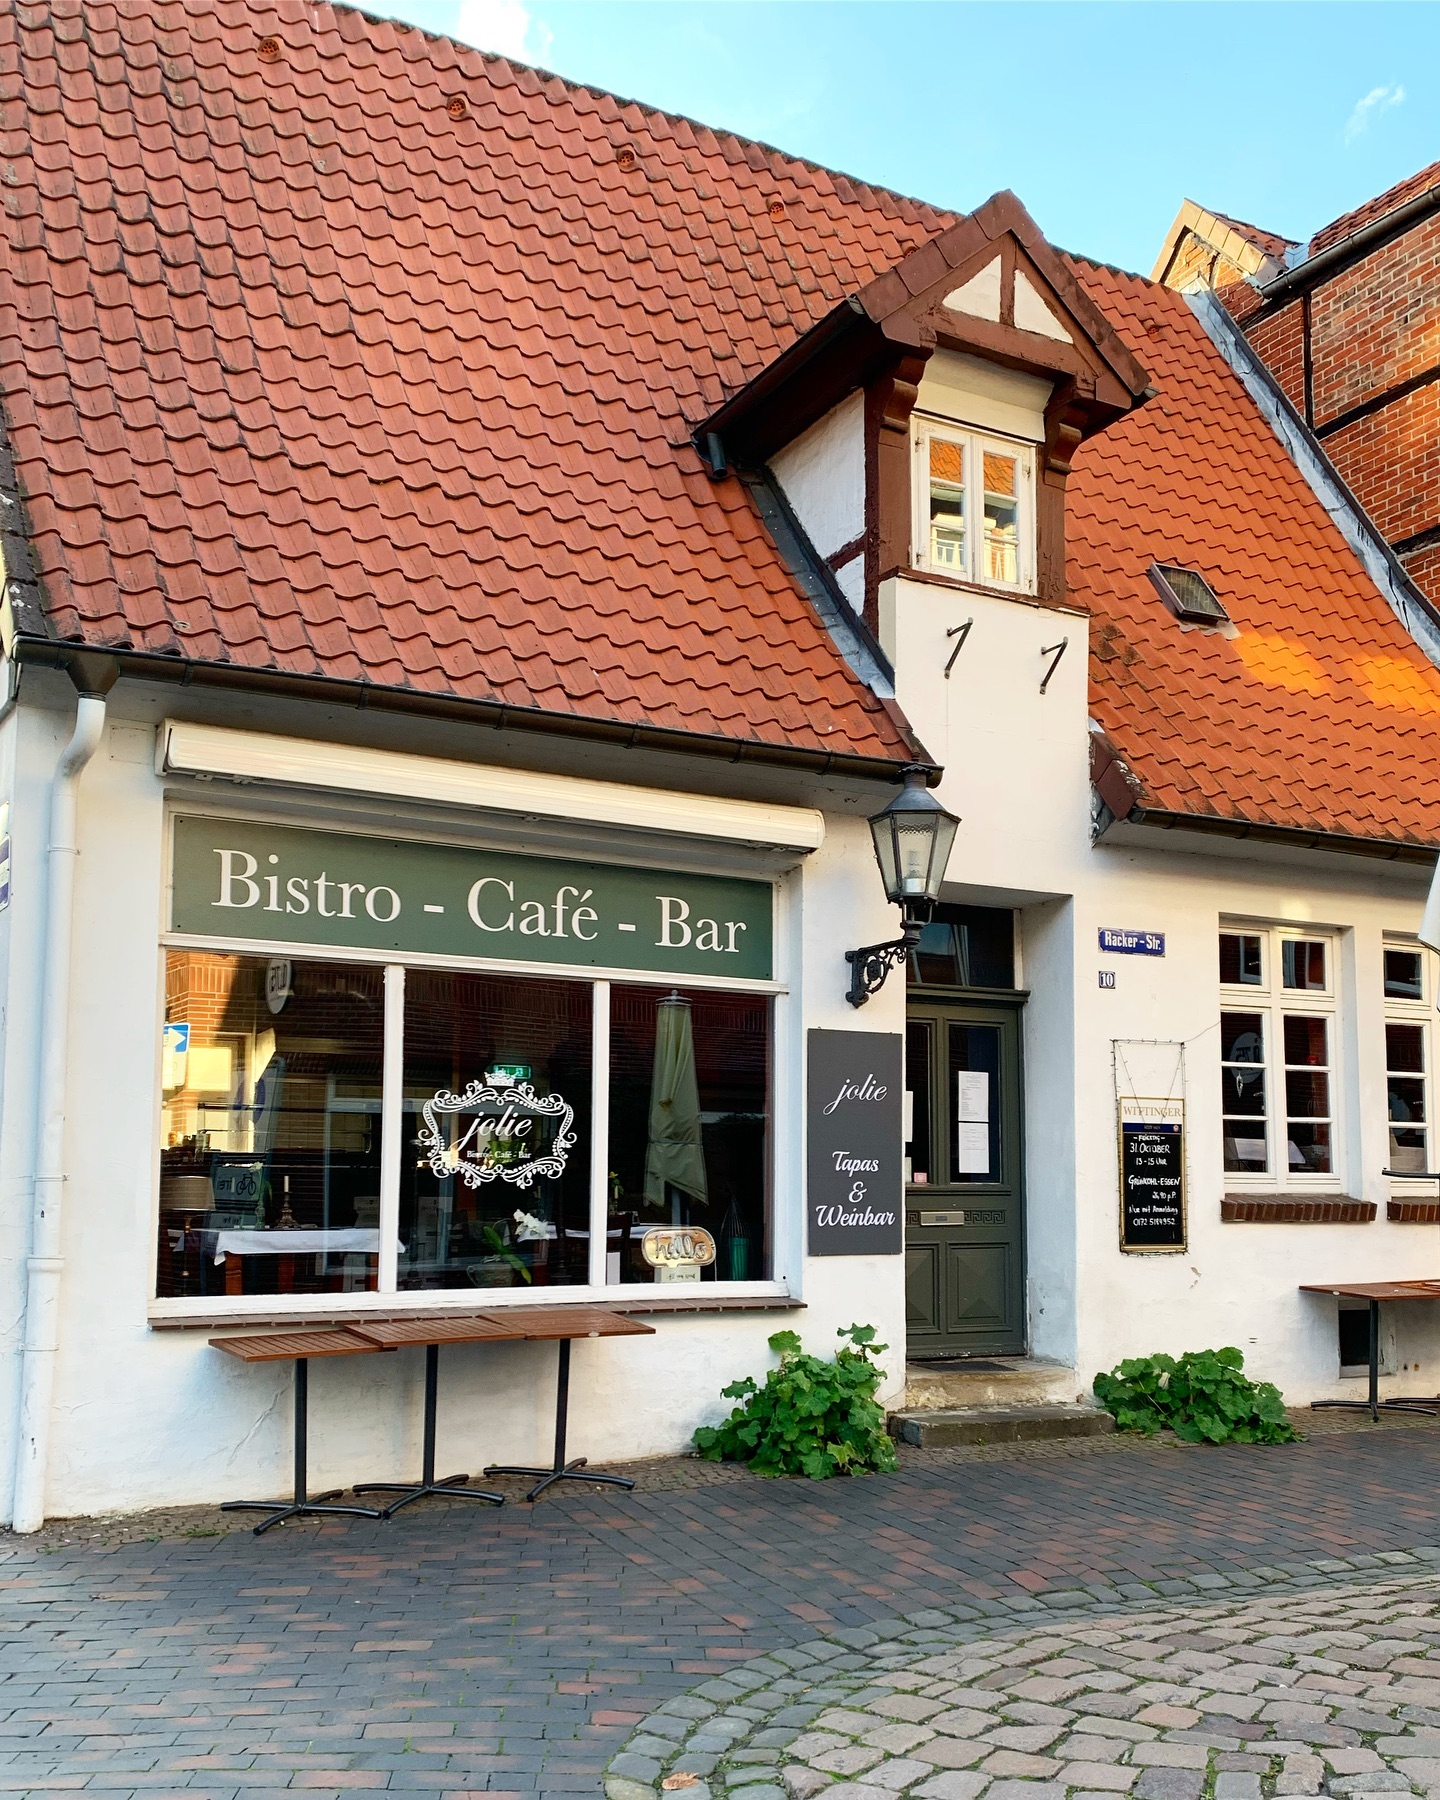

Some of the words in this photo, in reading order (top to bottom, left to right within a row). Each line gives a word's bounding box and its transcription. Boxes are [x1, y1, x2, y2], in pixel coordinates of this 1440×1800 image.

[211, 849, 400, 921] Bistro
[424, 905, 444, 913] -
[468, 878, 598, 940] Café
[655, 897, 746, 952] Bar
[1101, 973, 1114, 987] 10
[823, 1074, 887, 1115] jolie
[1123, 1106, 1182, 1117] WITTINGER
[448, 1105, 533, 1151] jolie
[833, 1151, 878, 1177] Tapas
[849, 1181, 867, 1203] &
[815, 1204, 895, 1227] Weinbar
